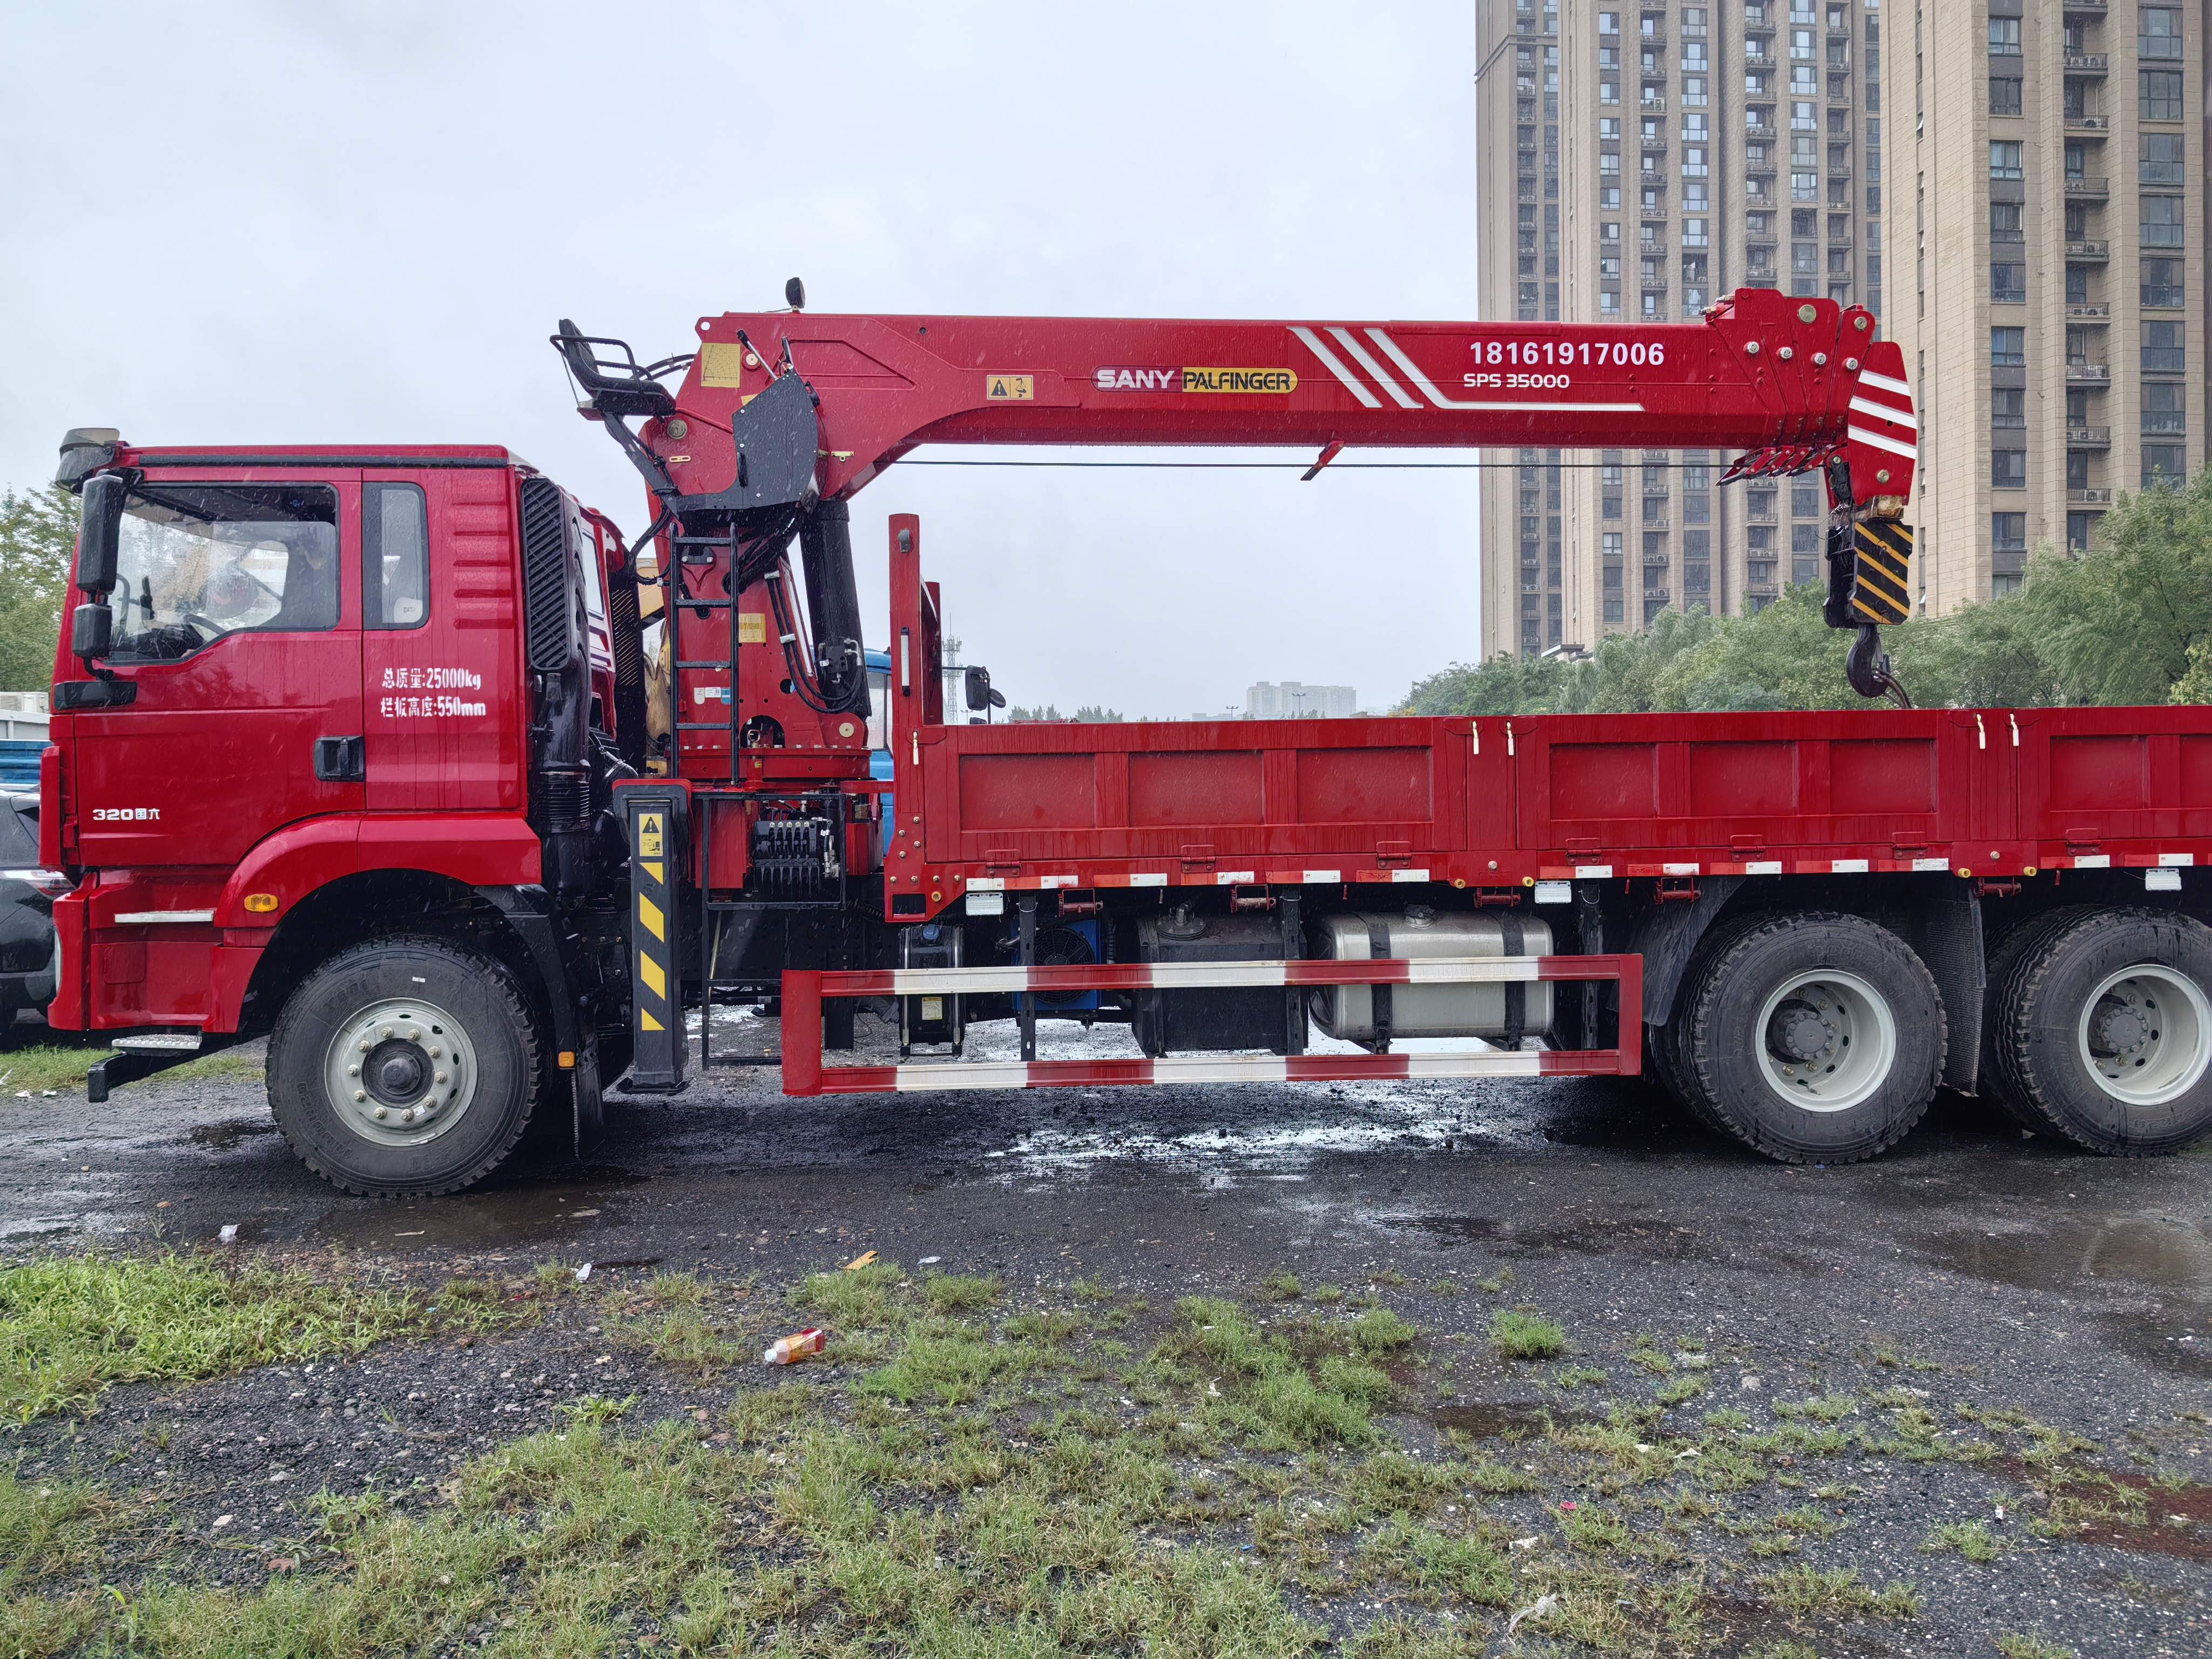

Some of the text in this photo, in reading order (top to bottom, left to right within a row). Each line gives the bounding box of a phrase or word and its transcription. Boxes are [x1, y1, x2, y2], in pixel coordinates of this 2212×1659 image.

[1469, 342, 1664, 365] 18161917006
[1097, 369, 1290, 390] SANY PALFINGER
[1464, 373, 1570, 388] SPS 35000
